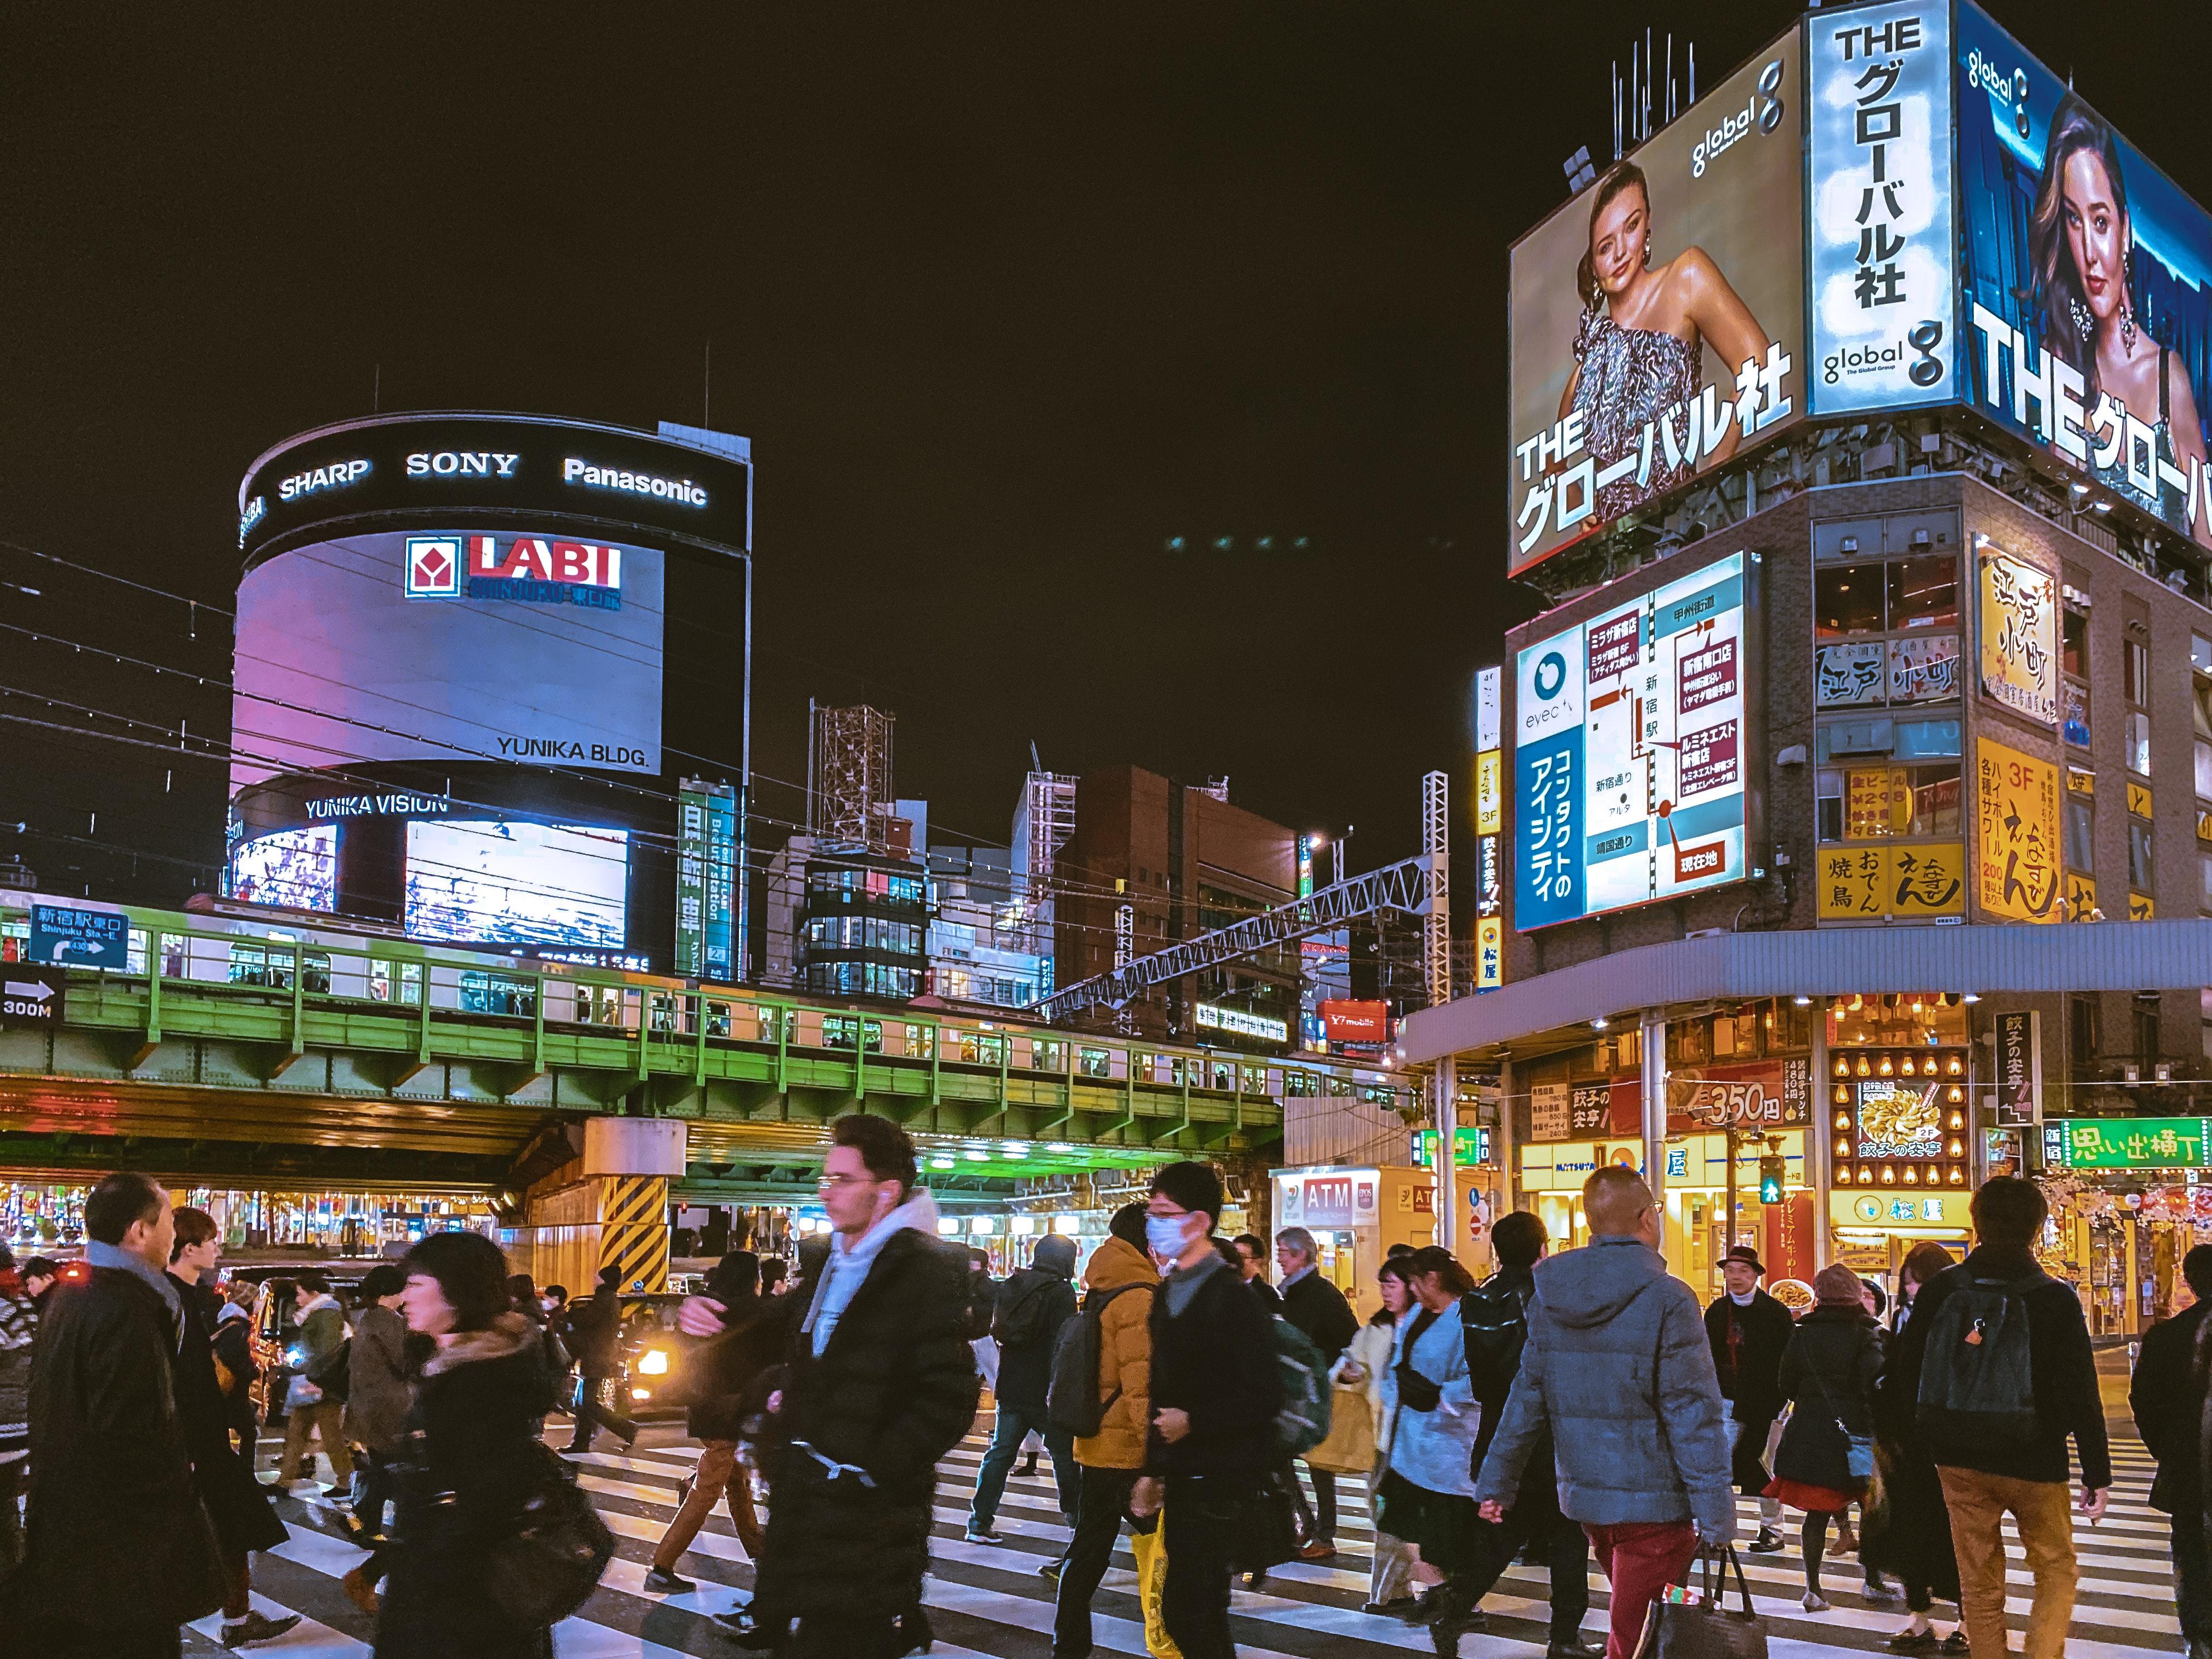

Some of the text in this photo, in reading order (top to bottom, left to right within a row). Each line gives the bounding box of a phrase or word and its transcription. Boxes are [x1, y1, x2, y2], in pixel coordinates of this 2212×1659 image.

[1835, 17, 1922, 61] THE
[1968, 51, 2012, 102] global
[1693, 95, 1755, 178] global
[1854, 58, 1907, 309] グローバル社
[1824, 341, 1903, 384] global
[1973, 301, 2086, 473] THE
[1516, 407, 1586, 482] THE
[1518, 342, 1793, 556] グローバル社
[279, 459, 369, 500] SHARP
[407, 453, 518, 476] SONY
[565, 458, 707, 506] Panasonic
[469, 535, 621, 589] LABI
[469, 578, 564, 603] SHINJUKU
[1674, 594, 1715, 622] 甲州街道
[1646, 674, 1658, 738] 新宿駅
[497, 737, 650, 768] YUNIKA BLDG.
[1681, 723, 1735, 753] ルミネエスト
[1596, 772, 1632, 793] 新宿通り
[2008, 761, 2034, 791] 3F
[306, 793, 448, 819] YUNIKA VISION
[1482, 810, 1497, 822] 3F
[1981, 757, 1992, 855] 各種サワー
[1991, 761, 2003, 857] ハイボール
[1531, 757, 1553, 902] アイシティ
[1556, 750, 1572, 898] コンタクトの
[1596, 834, 1633, 855] 靖国通り
[1680, 851, 1718, 873] 現在地
[1983, 862, 2002, 881] 200
[710, 871, 720, 920] station
[1829, 857, 1853, 909] 焼鳥
[1859, 850, 1881, 912] おでん
[38, 907, 121, 932] 新宿駅東口
[41, 923, 82, 936] Shinjuku
[1483, 947, 1497, 979] 松屋
[3, 1001, 52, 1018] 300M
[2006, 1016, 2024, 1090] 餃子の安亭
[1573, 1090, 1610, 1108] 餃子の
[1711, 1083, 1780, 1123] 350円
[1573, 1109, 1600, 1128] 安亭
[1920, 1128, 1934, 1137] 2F
[1858, 1140, 1942, 1159] 餃子の安亭
[2045, 1128, 2062, 1160] 新宿
[2072, 1127, 2201, 1161] 思い出横丁
[1556, 1162, 1596, 1172] MATSUYA
[1307, 1183, 1348, 1208] ATM
